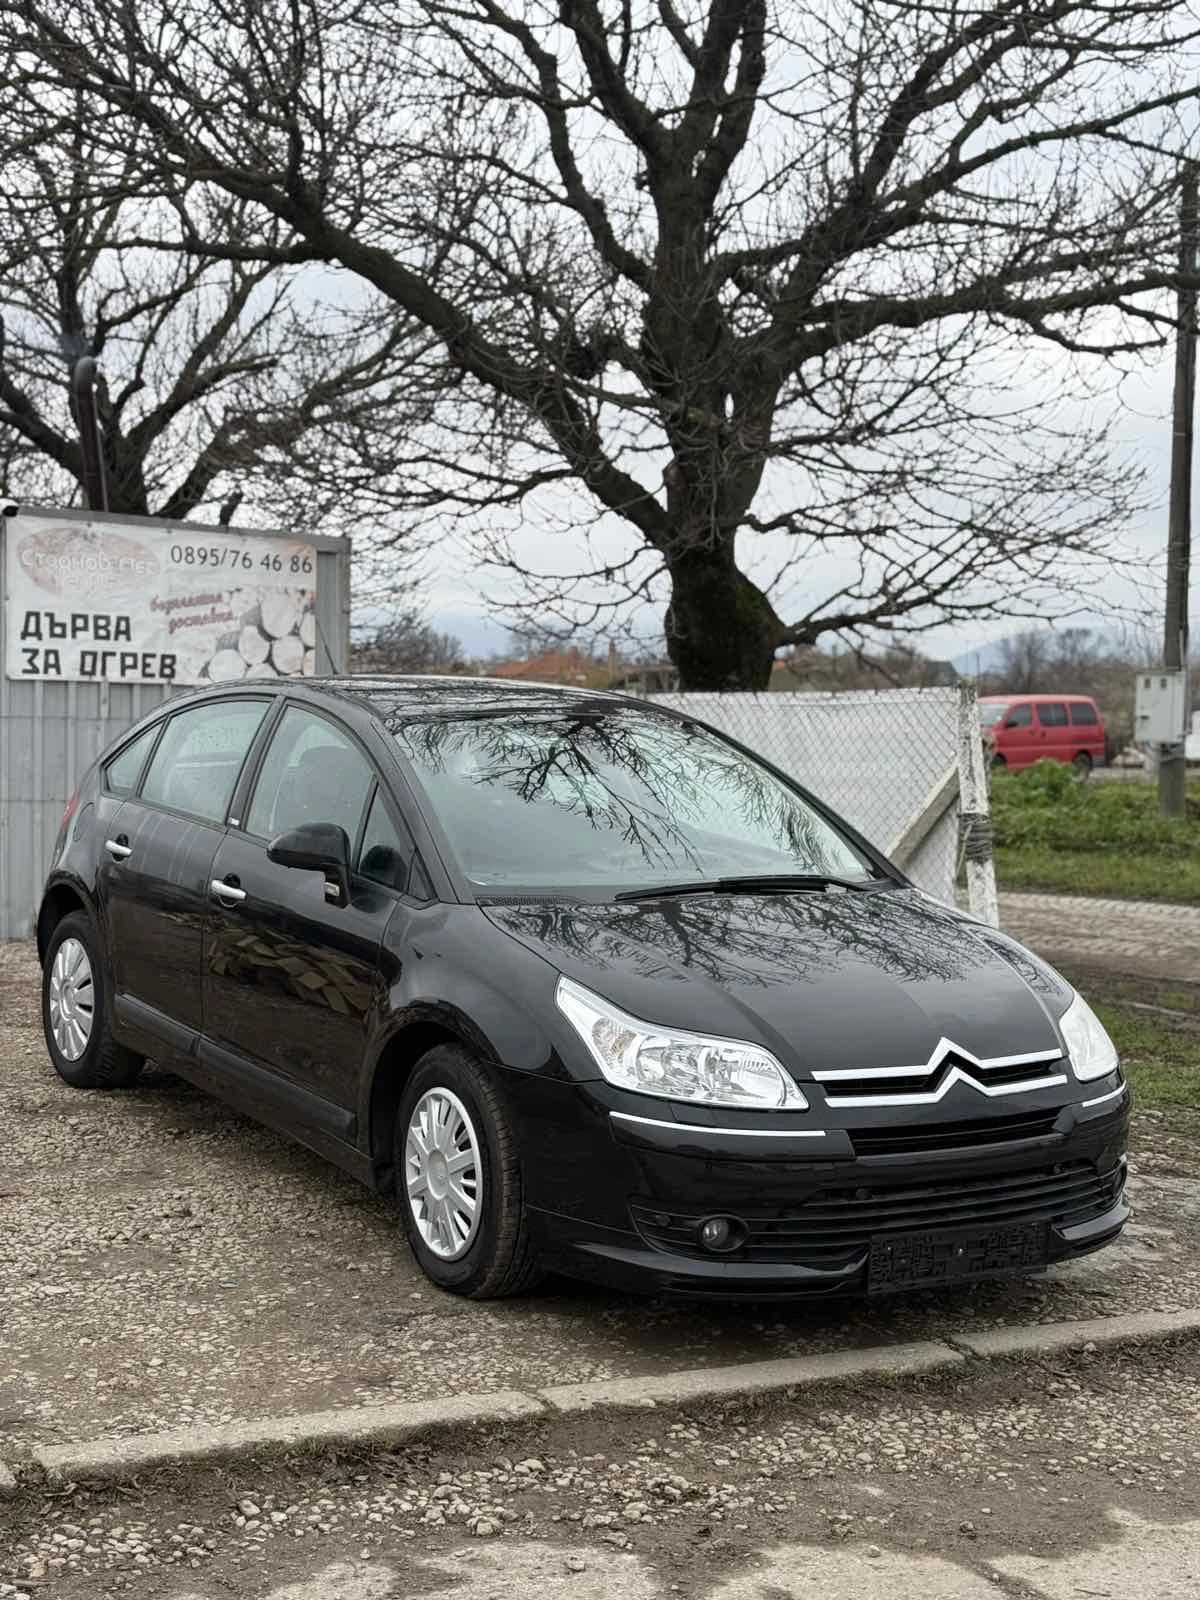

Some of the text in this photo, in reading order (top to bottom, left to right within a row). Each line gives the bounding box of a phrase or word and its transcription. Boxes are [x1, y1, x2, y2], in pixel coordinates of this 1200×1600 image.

[170, 545, 253, 569] 0895/76
[260, 553, 282, 573] 46
[290, 554, 313, 574] 86
[20, 611, 131, 641] ДЪРВА
[21, 648, 177, 679] ЗА ОГРЕВ
